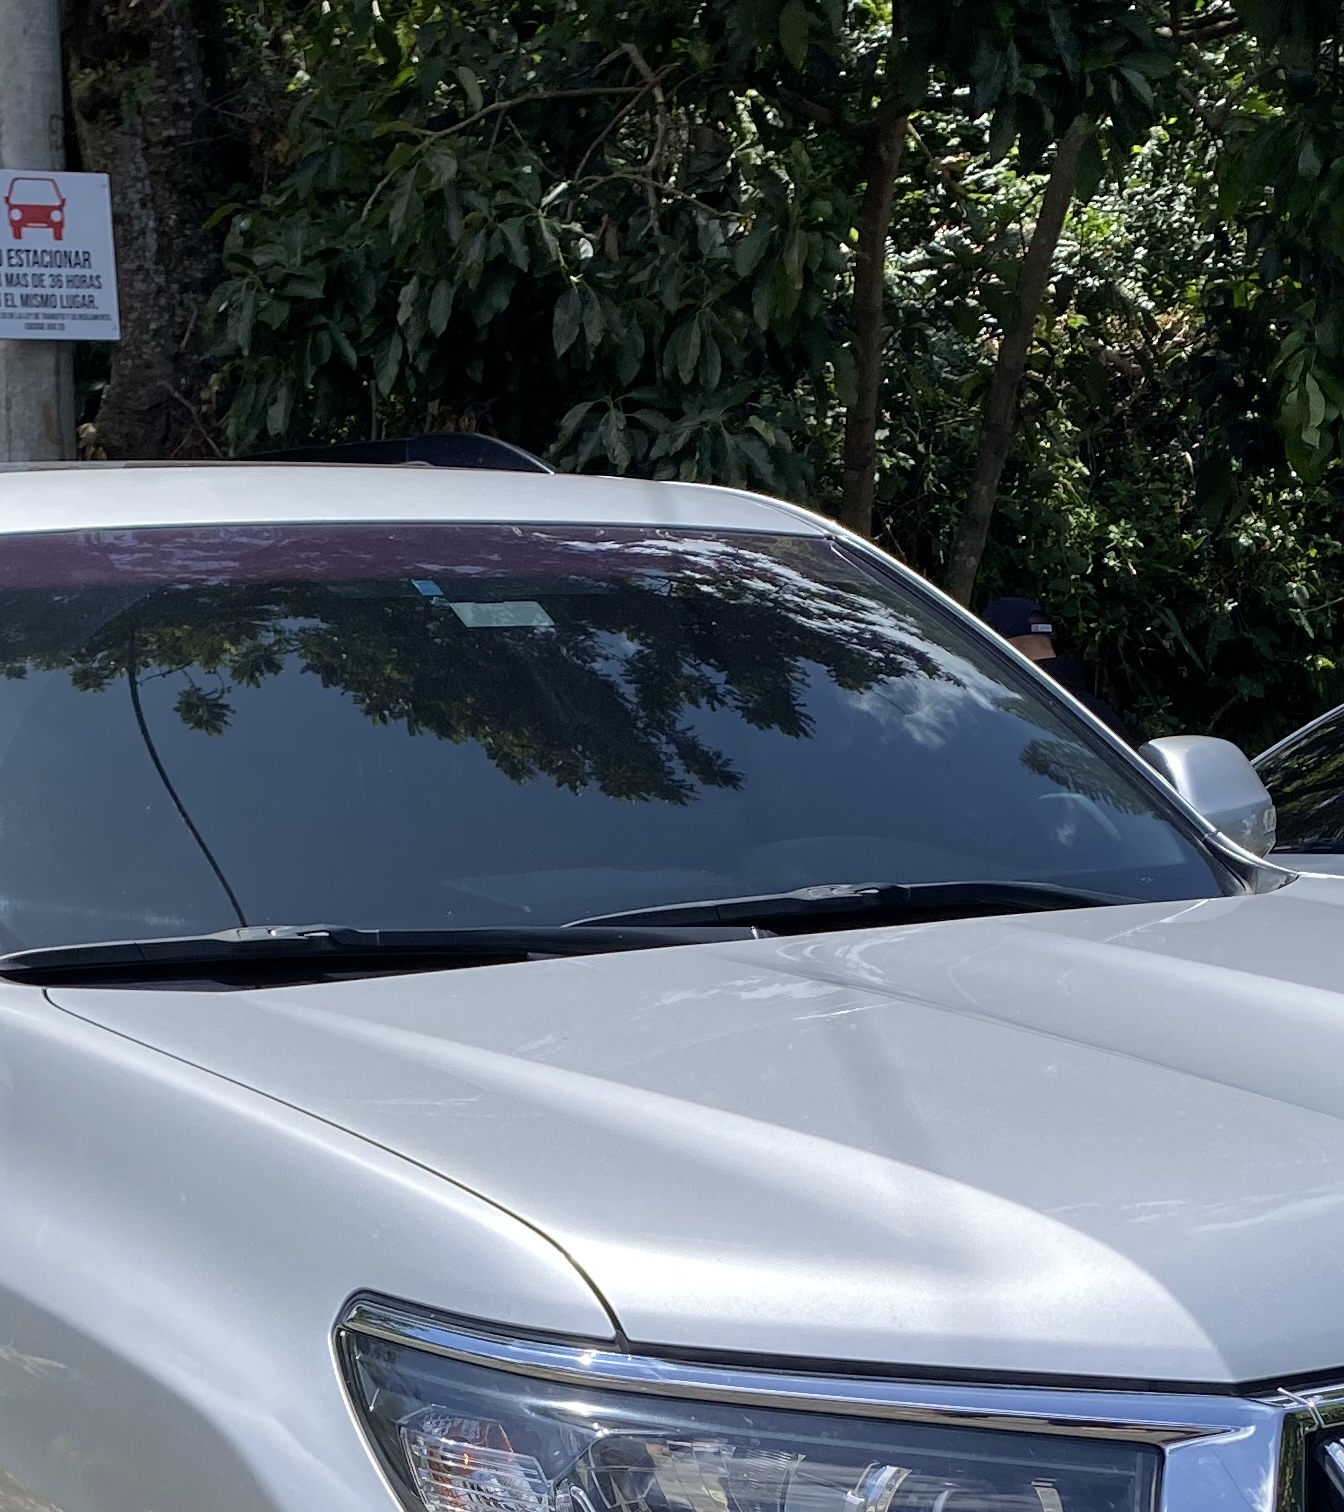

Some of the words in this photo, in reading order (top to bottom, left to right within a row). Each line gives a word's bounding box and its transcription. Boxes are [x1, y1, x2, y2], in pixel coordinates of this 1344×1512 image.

[7, 249, 92, 269] ESTACIONAR
[31, 273, 46, 288] DE
[48, 273, 63, 289] 36
[66, 274, 102, 289] HORAS
[4, 292, 18, 308] EL
[20, 292, 56, 309] MISMO
